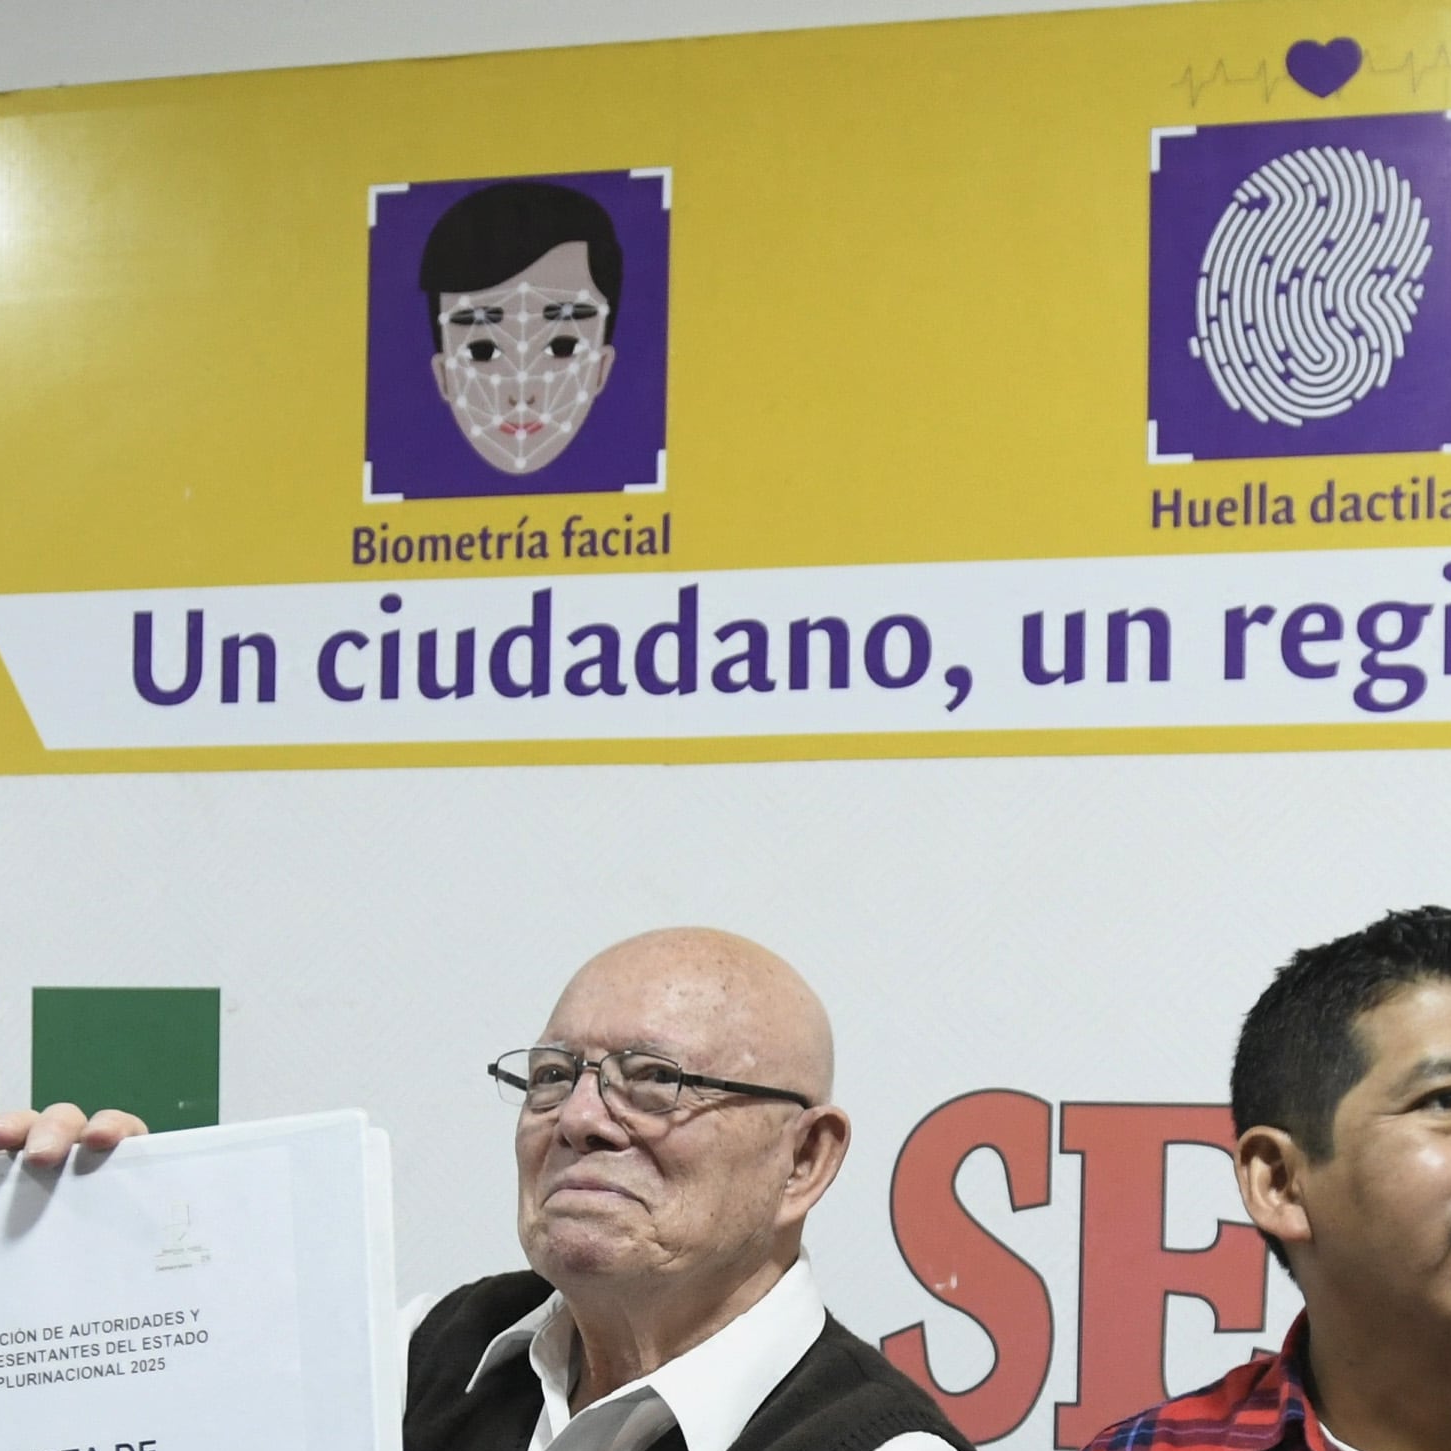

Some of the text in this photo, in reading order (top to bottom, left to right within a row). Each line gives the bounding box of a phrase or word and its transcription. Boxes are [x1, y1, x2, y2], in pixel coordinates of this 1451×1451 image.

[1151, 484, 1296, 528] Huella
[351, 512, 672, 567] Biometría facial
[131, 608, 277, 706] Un
[317, 583, 973, 713] ciudadano,
[1022, 605, 1172, 687] un
[43, 1325, 64, 1341] DE
[69, 1310, 185, 1338] AUTORIDADES
[190, 1308, 201, 1322] Y
[106, 1338, 137, 1355] DEL
[142, 1329, 210, 1351] ESTADO
[131, 1357, 167, 1375] 2025
